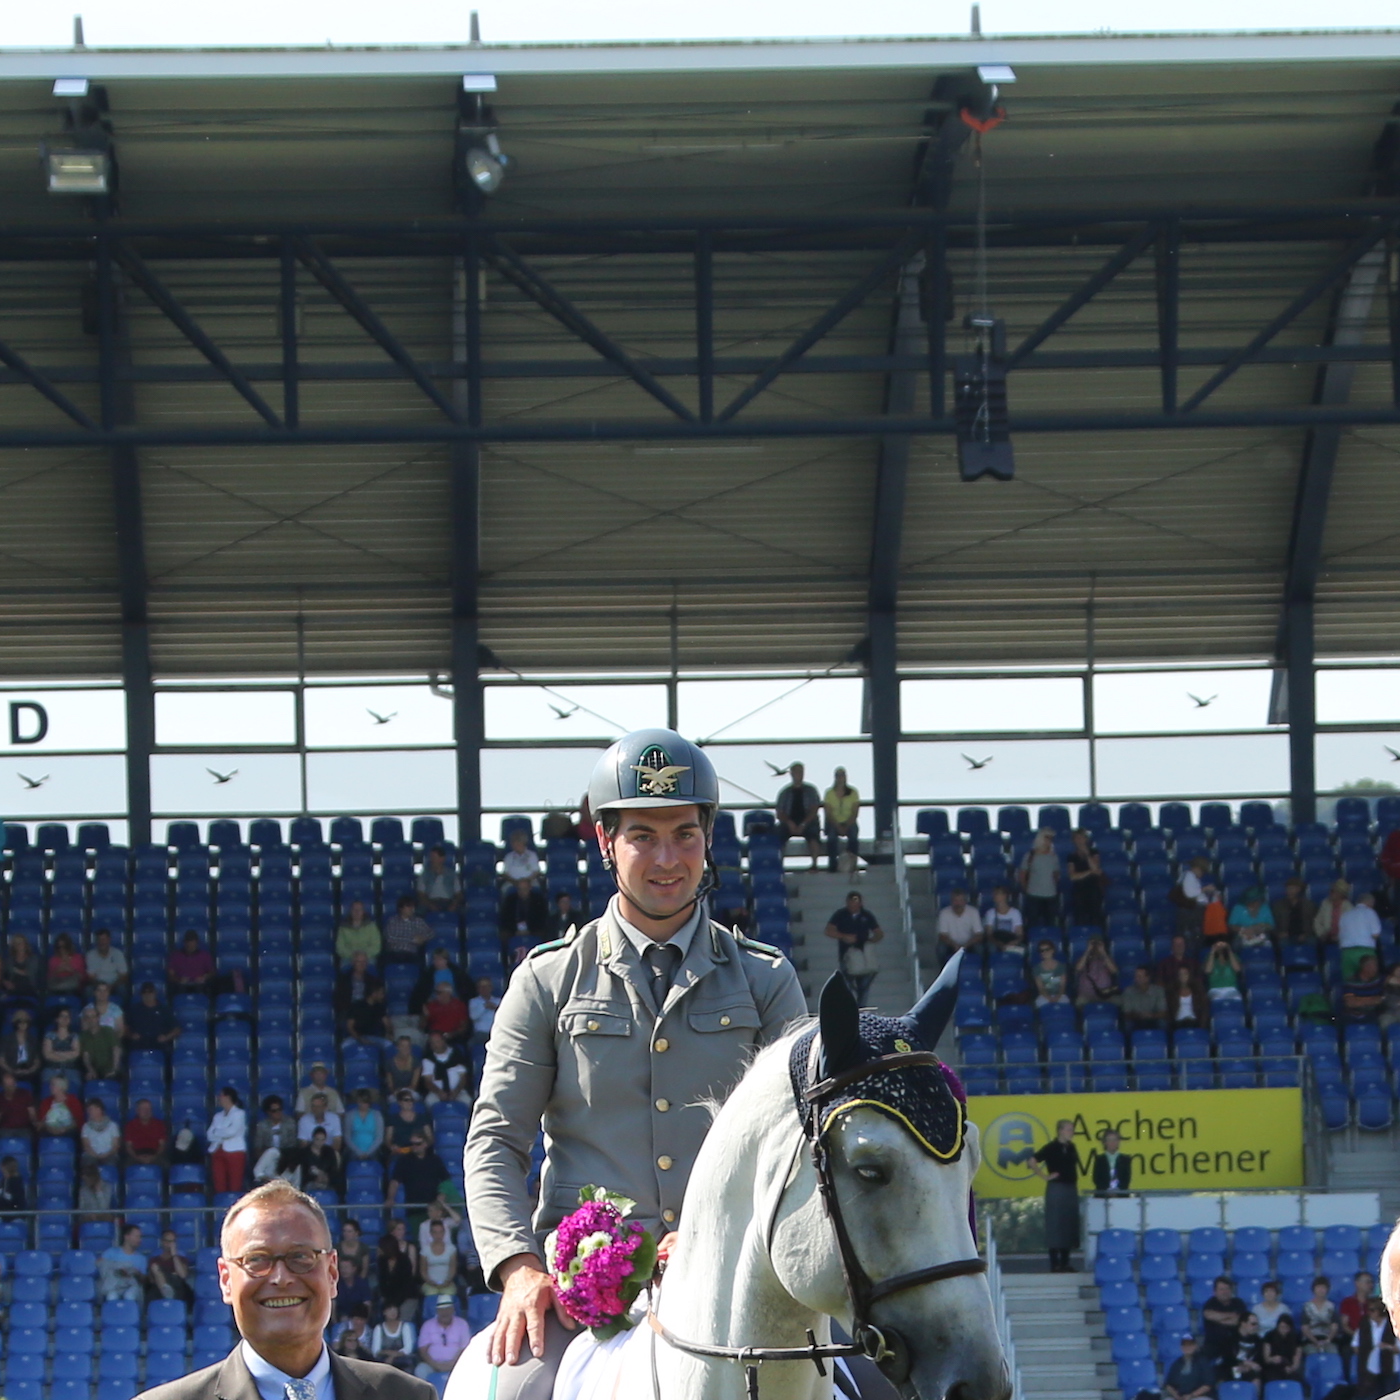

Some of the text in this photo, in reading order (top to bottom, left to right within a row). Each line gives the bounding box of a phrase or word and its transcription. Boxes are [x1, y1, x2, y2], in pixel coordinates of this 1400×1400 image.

[8, 700, 49, 745] D
[1072, 1109, 1197, 1142] Aachen
[1077, 1144, 1270, 1176] Mnchener
